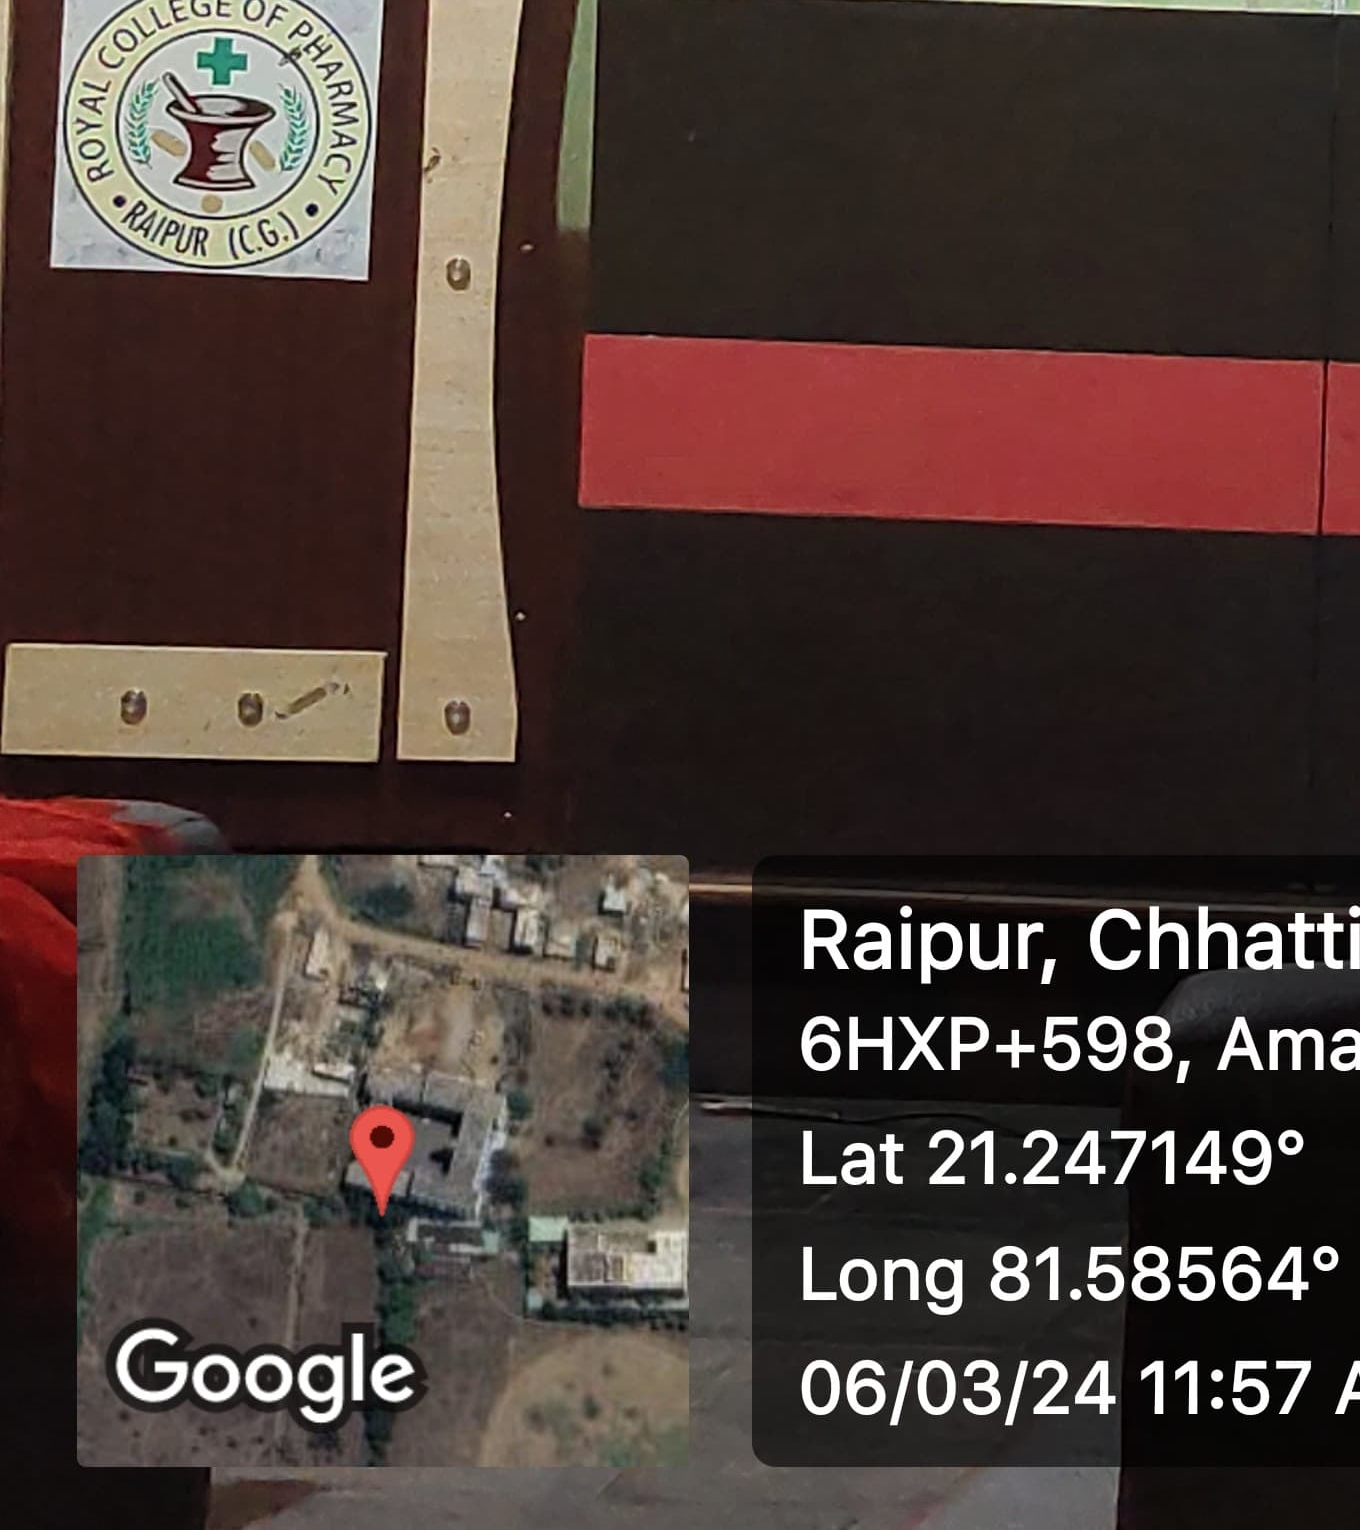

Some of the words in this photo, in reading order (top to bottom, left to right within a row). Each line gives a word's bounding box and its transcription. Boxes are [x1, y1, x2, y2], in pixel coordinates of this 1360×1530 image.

[76, 80, 115, 183] ROYAL
[287, 20, 359, 196] PHARMACY
[120, 200, 208, 256] RAIPUR
[228, 211, 300, 260] (C.G.)
